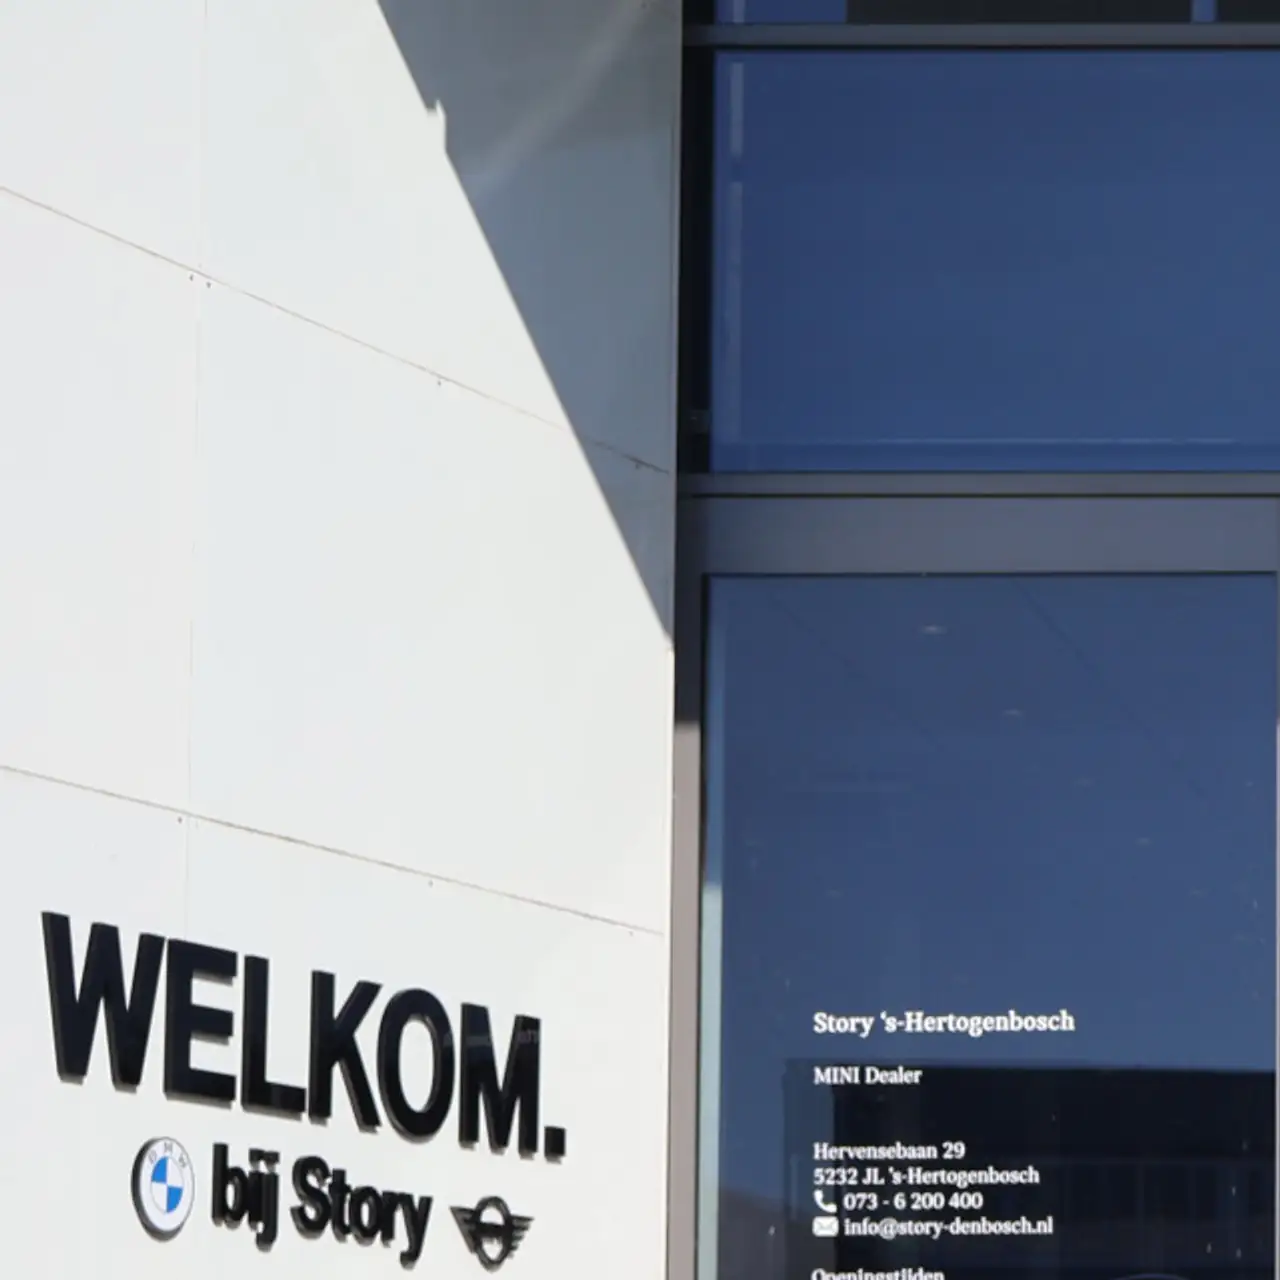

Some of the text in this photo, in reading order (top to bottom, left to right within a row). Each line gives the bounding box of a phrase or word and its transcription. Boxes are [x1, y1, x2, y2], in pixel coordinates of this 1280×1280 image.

[813, 1009, 1076, 1038] Story 's-Hertogenbosch
[41, 911, 566, 1162] WELKOM.
[813, 1065, 922, 1085] MINI Dealer
[813, 1141, 966, 1160] Hervensebaan 29
[813, 1165, 1040, 1188] 5232 JL 's-Hertogenbosch
[211, 1143, 432, 1271] bij Story
[843, 1192, 878, 1211] 073
[894, 1192, 906, 1210] 6
[911, 1192, 945, 1210] 200
[948, 1191, 984, 1210] 400
[843, 1216, 1054, 1240] info@story-denbosch.nl
